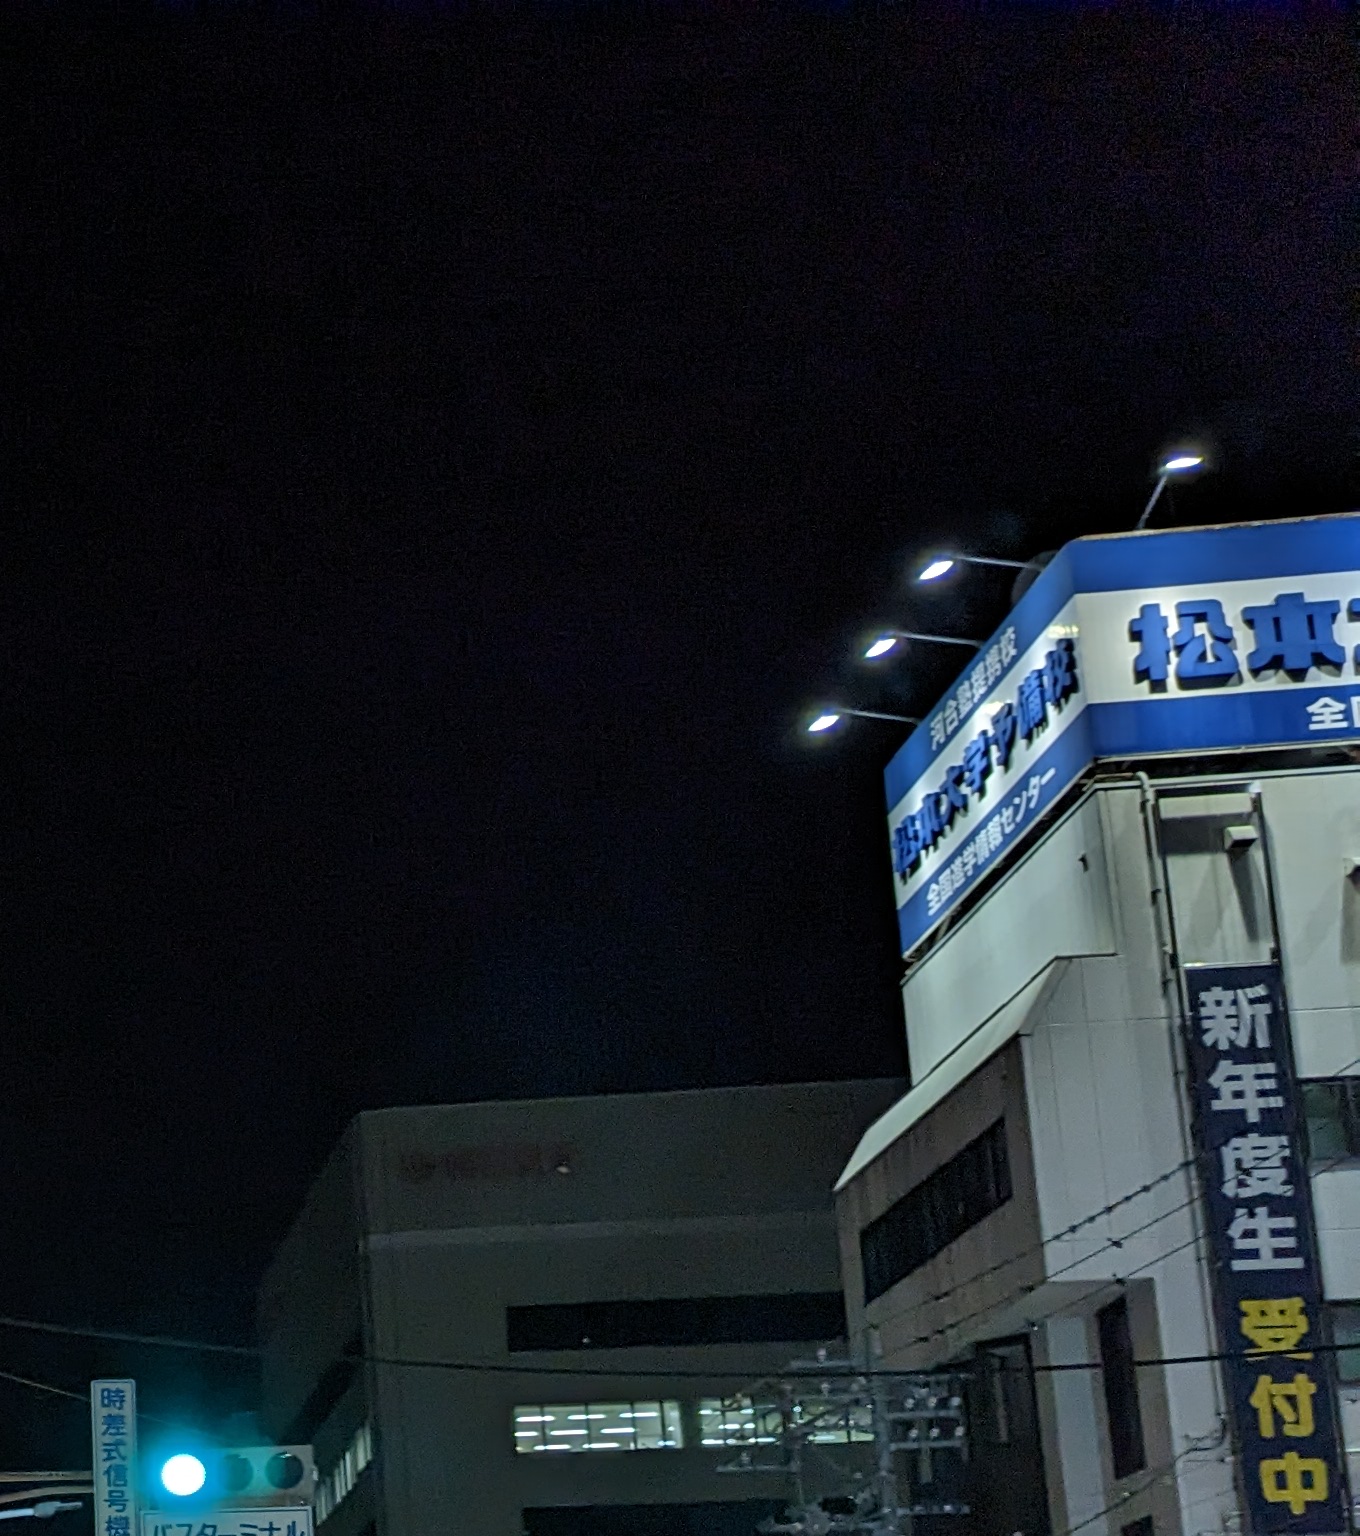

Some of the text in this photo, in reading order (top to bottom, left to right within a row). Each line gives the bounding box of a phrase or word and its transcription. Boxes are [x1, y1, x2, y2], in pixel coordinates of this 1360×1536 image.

[928, 626, 1018, 748] 河合塾提携校
[1129, 592, 1360, 692] 松本
[891, 638, 1079, 880] 松本大学予備校
[1306, 697, 1360, 730] 全
[1197, 983, 1329, 1516] 新年度生受付中
